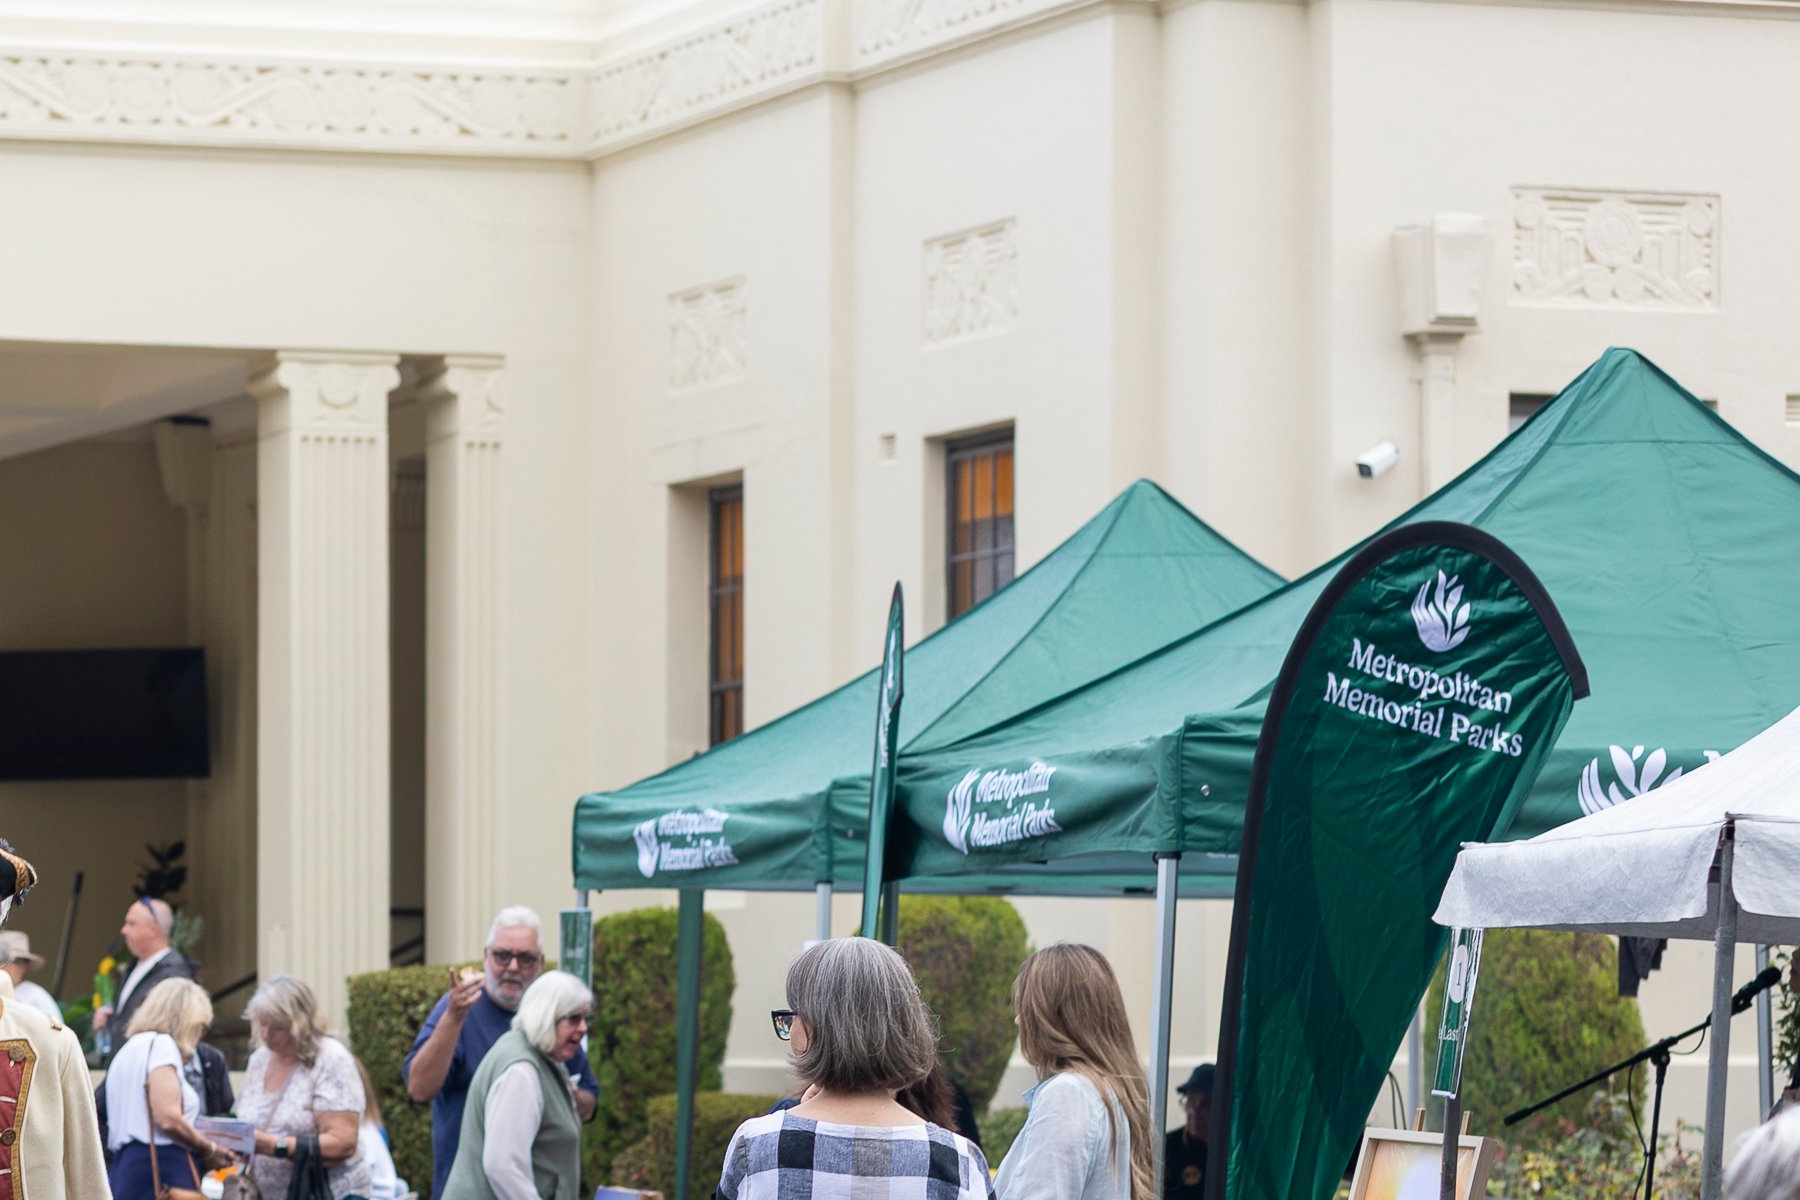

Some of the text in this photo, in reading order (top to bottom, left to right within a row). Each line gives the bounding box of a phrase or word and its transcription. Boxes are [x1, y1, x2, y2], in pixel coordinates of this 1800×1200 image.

[1323, 671, 1523, 757] Memorial Parks
[1347, 637, 1513, 714] Metropolitan
